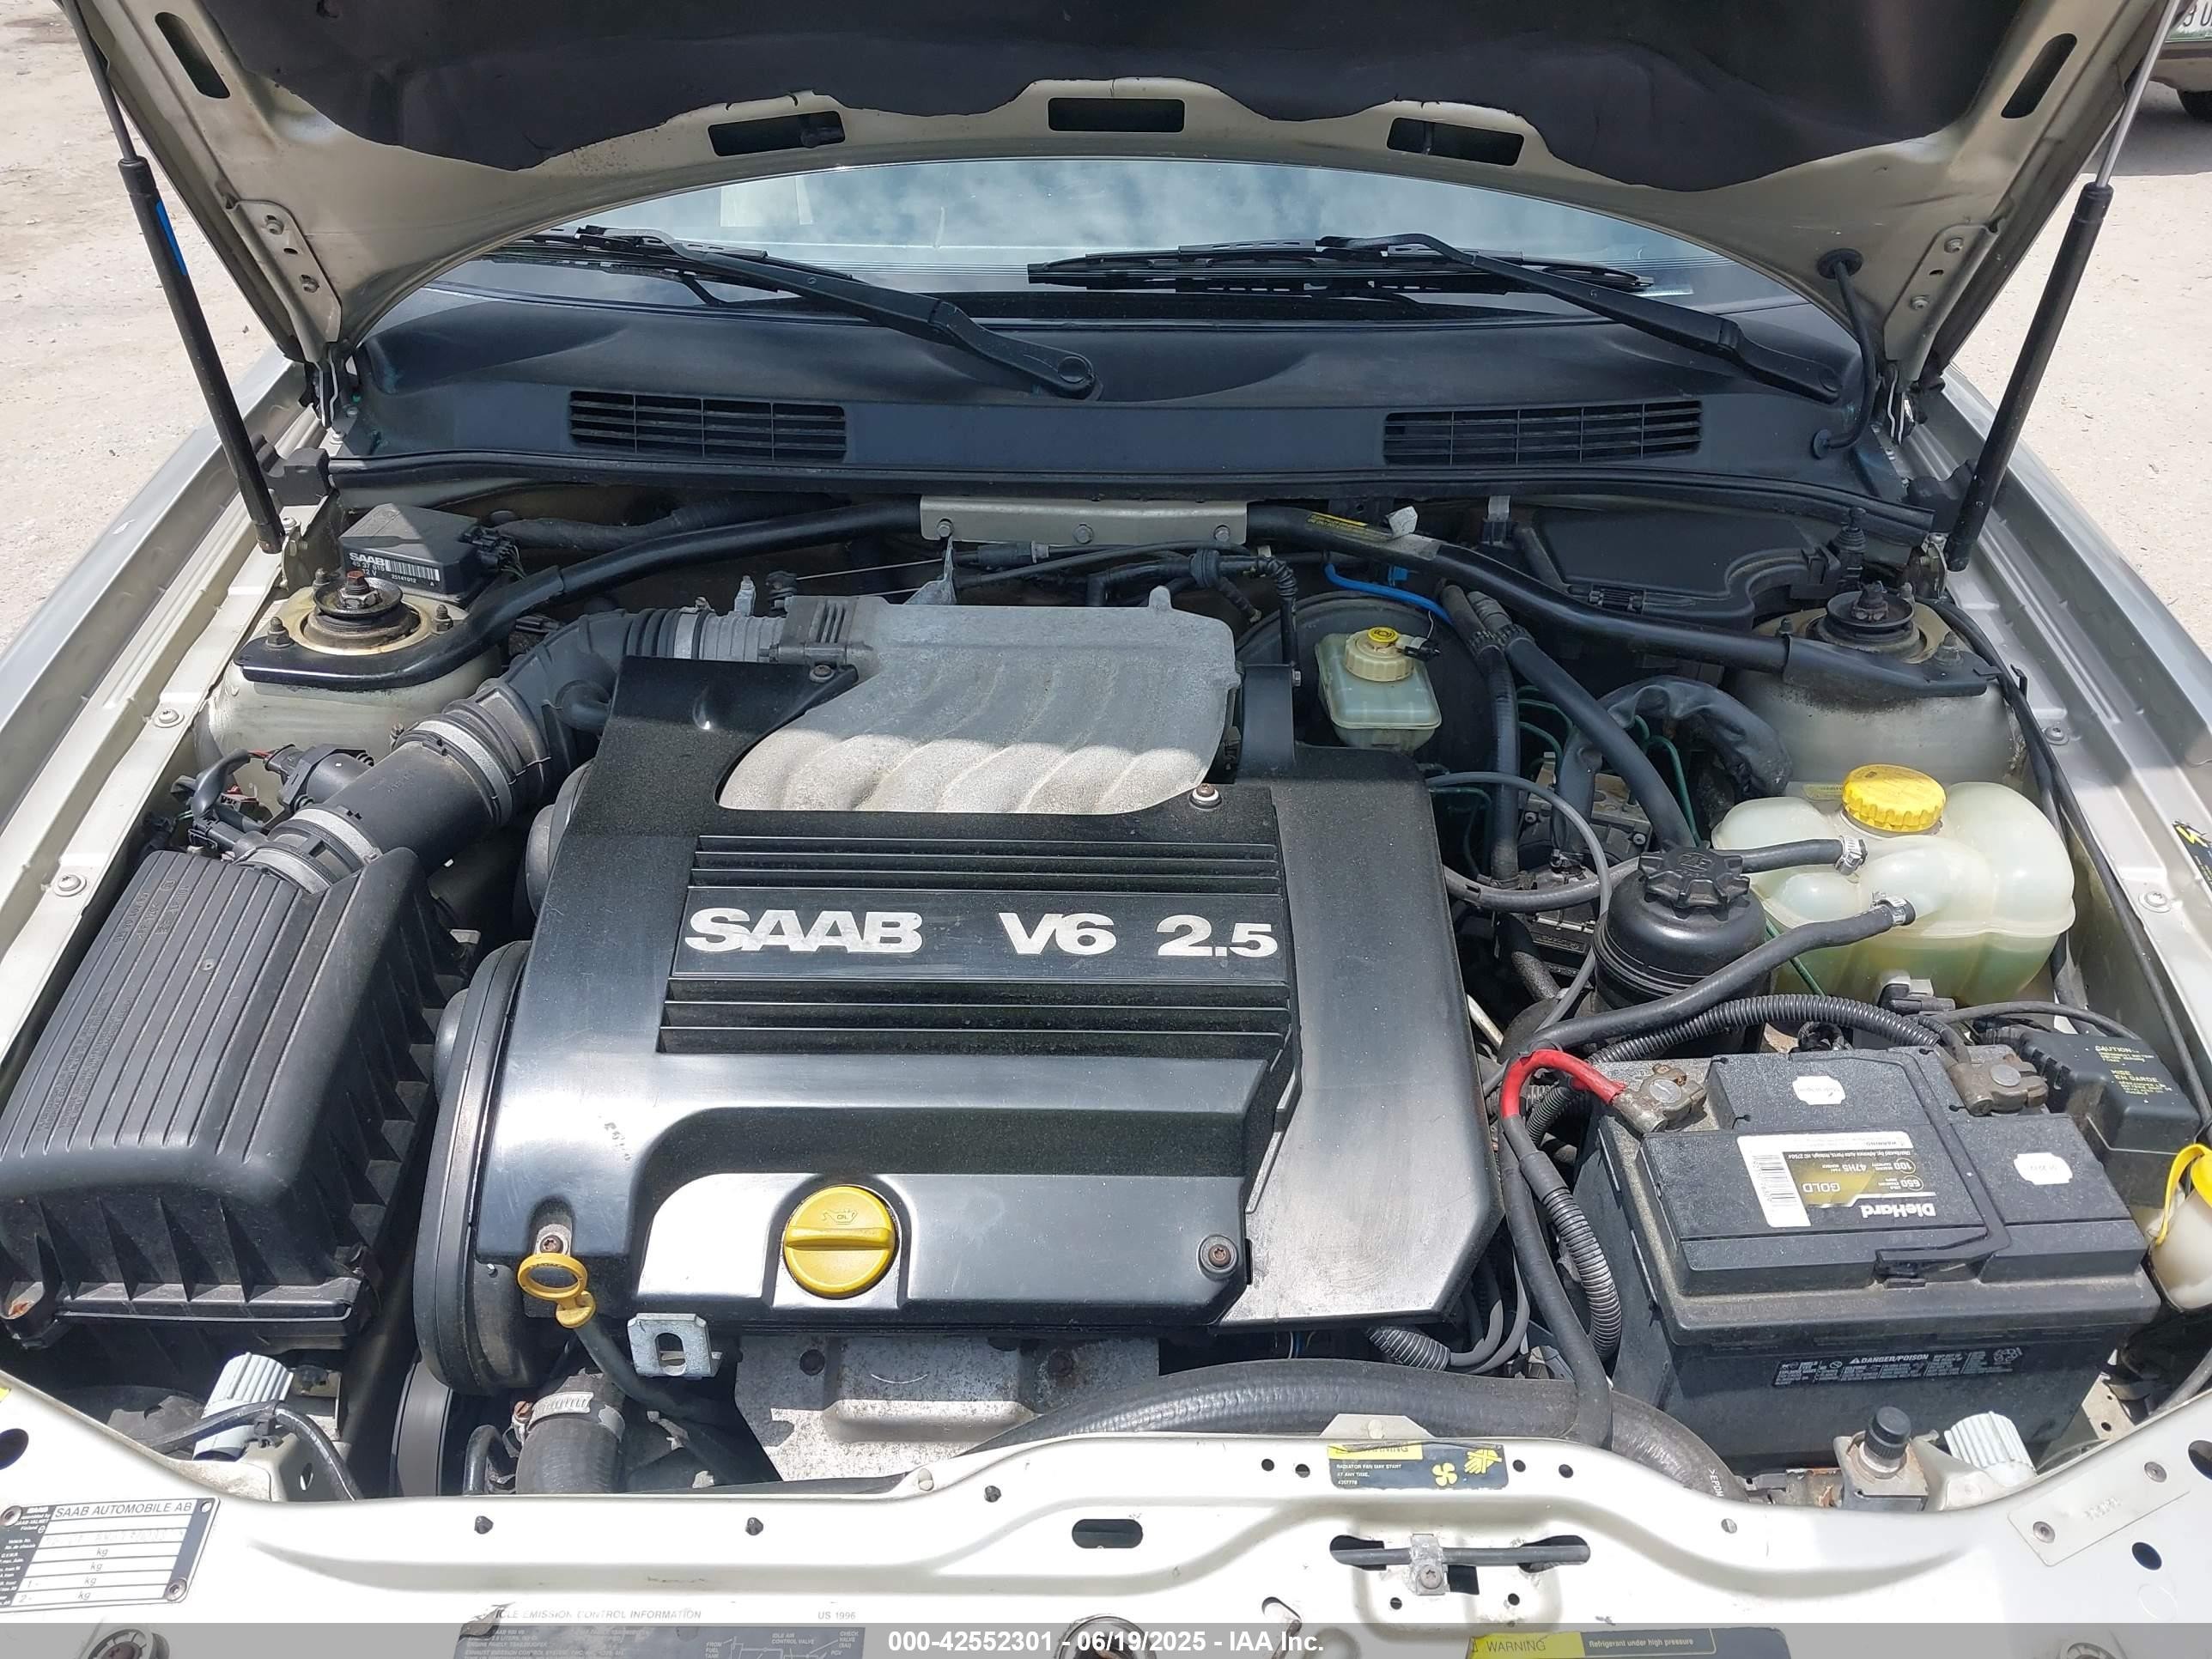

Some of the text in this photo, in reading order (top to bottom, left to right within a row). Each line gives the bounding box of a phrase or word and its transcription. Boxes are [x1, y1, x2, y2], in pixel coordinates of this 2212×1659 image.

[349, 552, 385, 566] SAAB
[685, 908, 1278, 957] SAAB V6 2.5
[1893, 1161, 1911, 1170] 100
[1802, 1182, 1841, 1193] GOLD
[1900, 1178, 1921, 1188] 650
[1861, 1203, 1936, 1219] DieHard
[1860, 1353, 1929, 1364] DANGER/POISON
[55, 1501, 191, 1518] SAAB AUTOMOBILE AB
[96, 1547, 109, 1558] kg
[90, 1562, 103, 1571] kg
[84, 1576, 97, 1586] kg
[77, 1590, 91, 1601] kg
[522, 1609, 573, 1620] EMISSION
[577, 1609, 627, 1619] CONTROL
[629, 1608, 702, 1620] INFORMATION
[817, 1610, 857, 1620] US 1996
[1486, 1638, 1693, 1653] WARNING Refrigerant under high pressure
